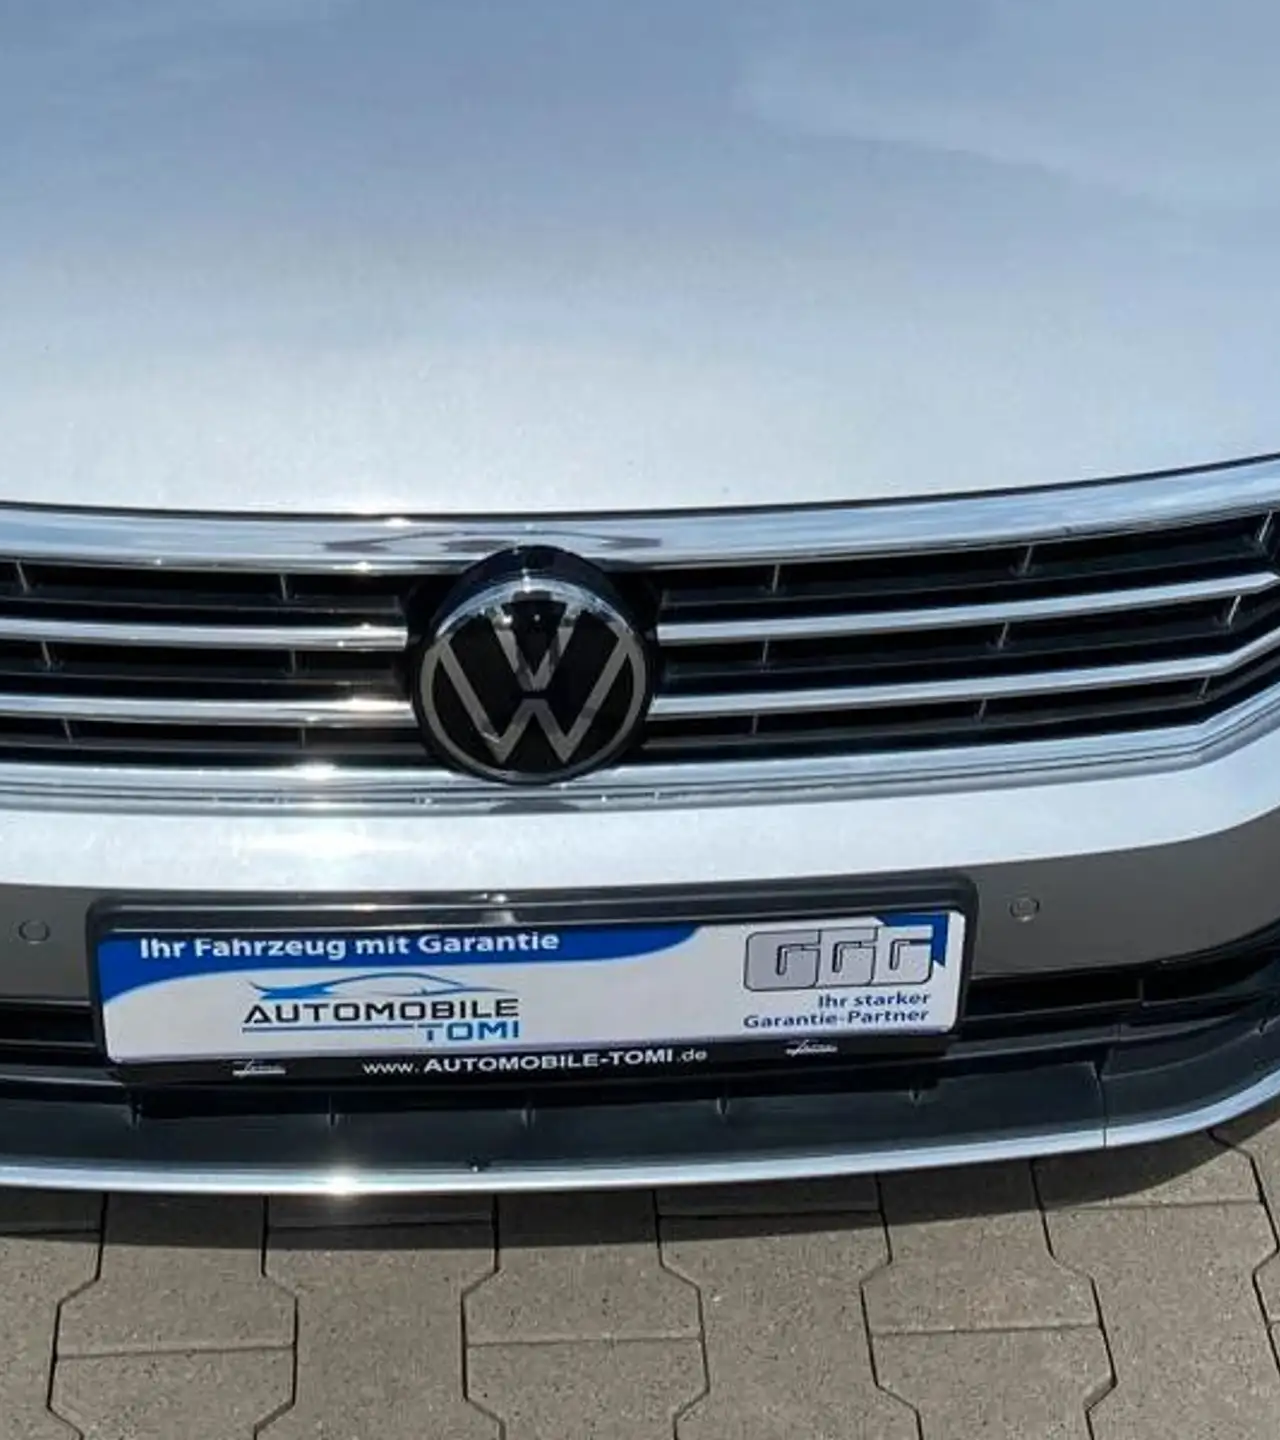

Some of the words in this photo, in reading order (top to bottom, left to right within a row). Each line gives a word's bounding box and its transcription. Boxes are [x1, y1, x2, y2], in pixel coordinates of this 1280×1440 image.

[140, 938, 186, 958] Ihr
[194, 937, 347, 960] Fahrzeug
[355, 935, 410, 955] mit
[418, 931, 561, 953] Garantie
[818, 993, 848, 1009] Ihr
[853, 990, 931, 1007] starker
[243, 998, 519, 1024] AUTOMOBILE
[742, 1010, 930, 1029] Garantie-Partner
[417, 1020, 519, 1042] TOMI
